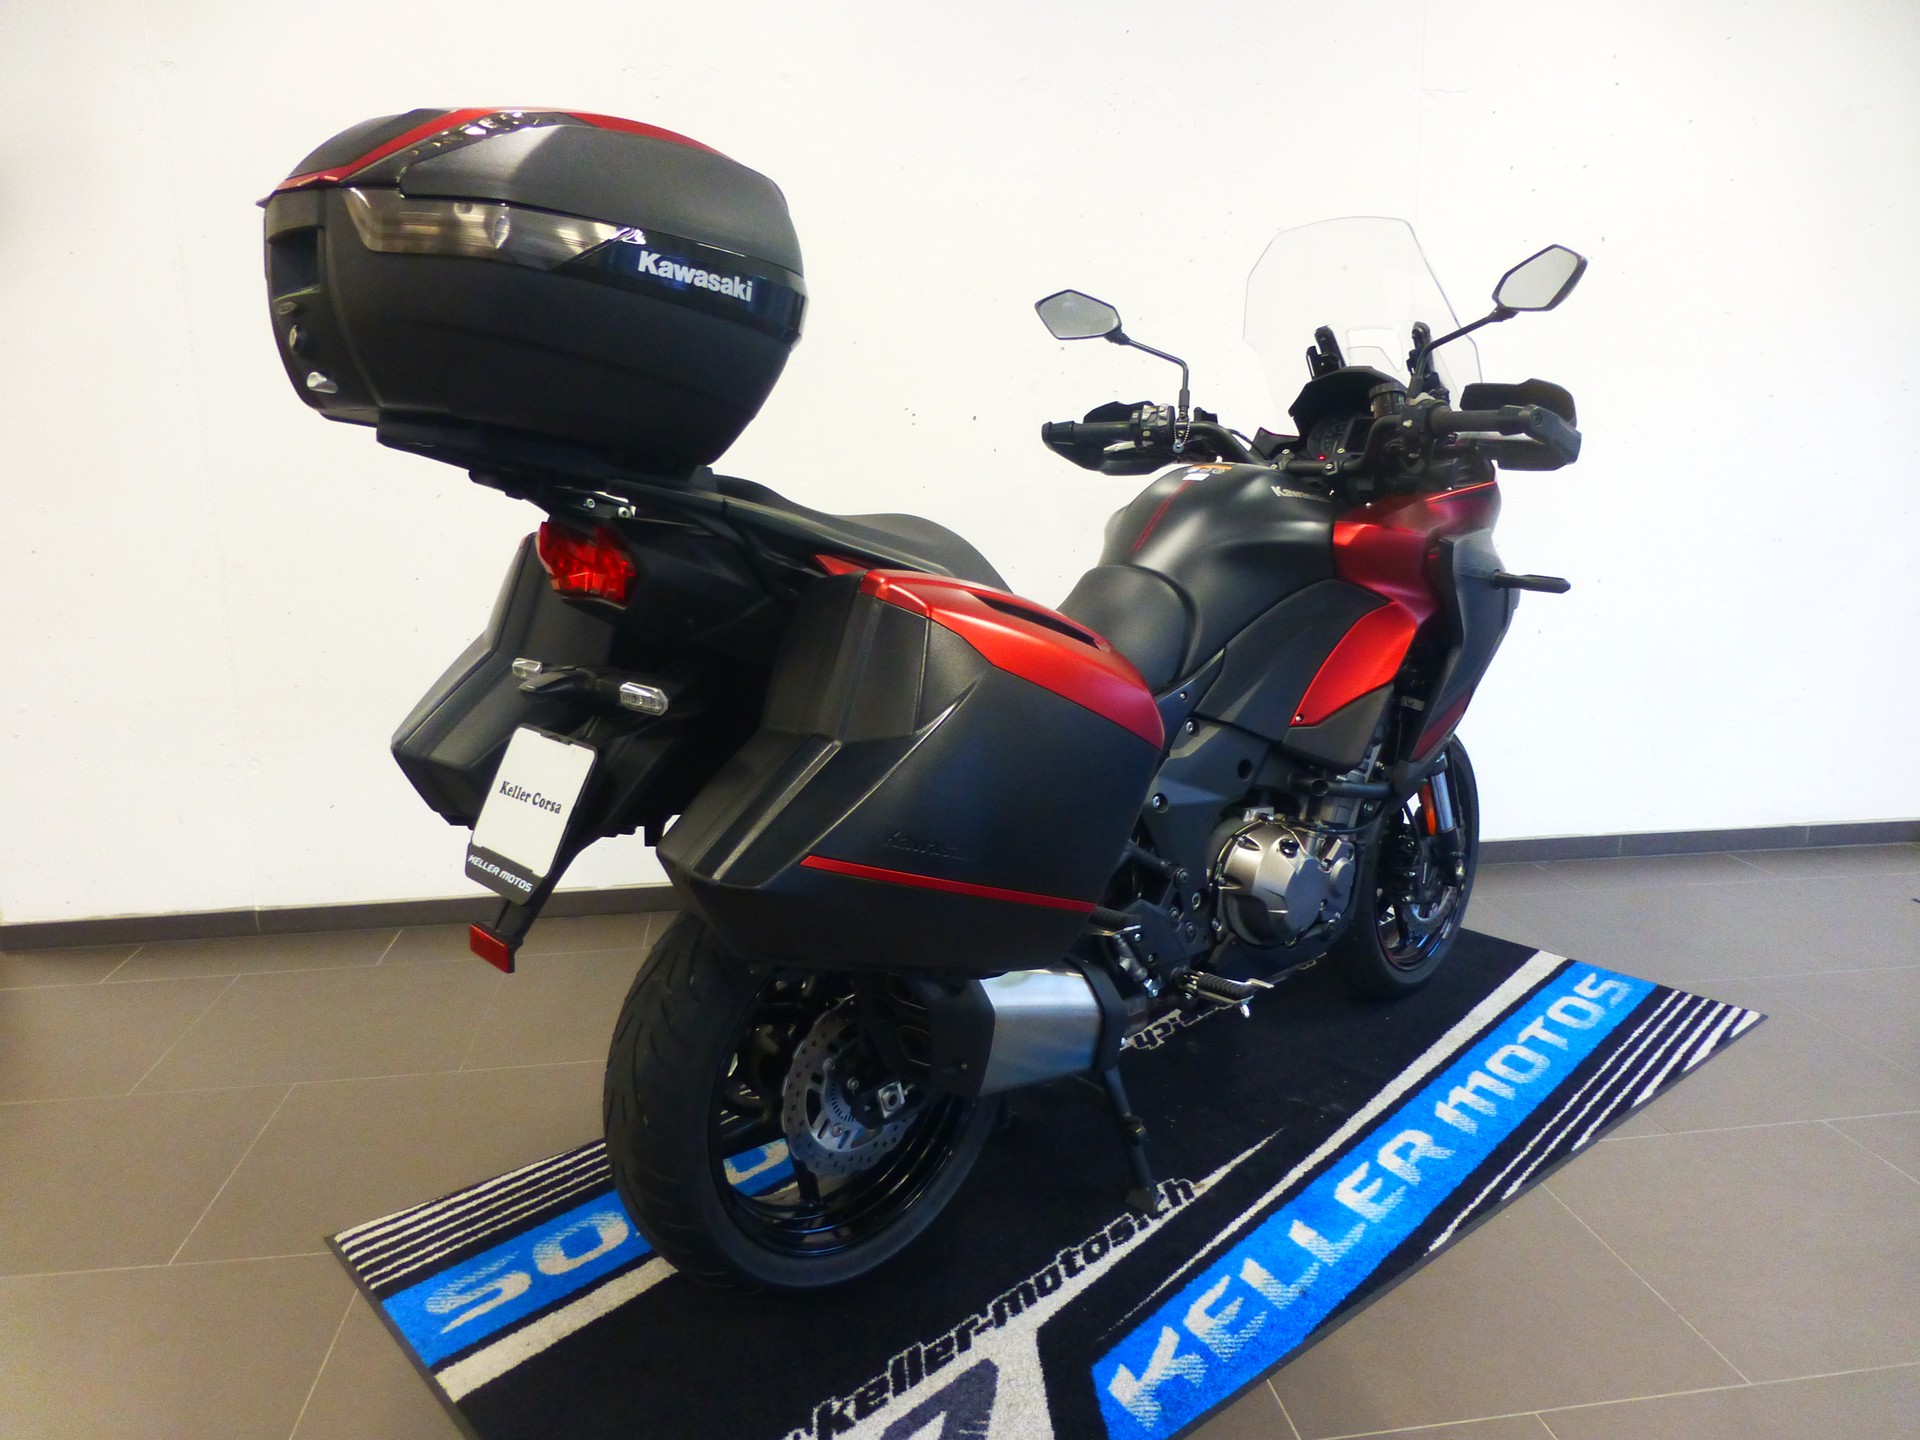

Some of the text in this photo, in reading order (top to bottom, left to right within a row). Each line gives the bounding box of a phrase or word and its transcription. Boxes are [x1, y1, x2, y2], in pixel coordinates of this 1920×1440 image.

[638, 249, 753, 302] Kawasaki
[499, 780, 562, 814] Keller Corsa
[468, 854, 534, 893] KELLER MOTOS
[1107, 972, 1633, 1431] KELLER MOTOS
